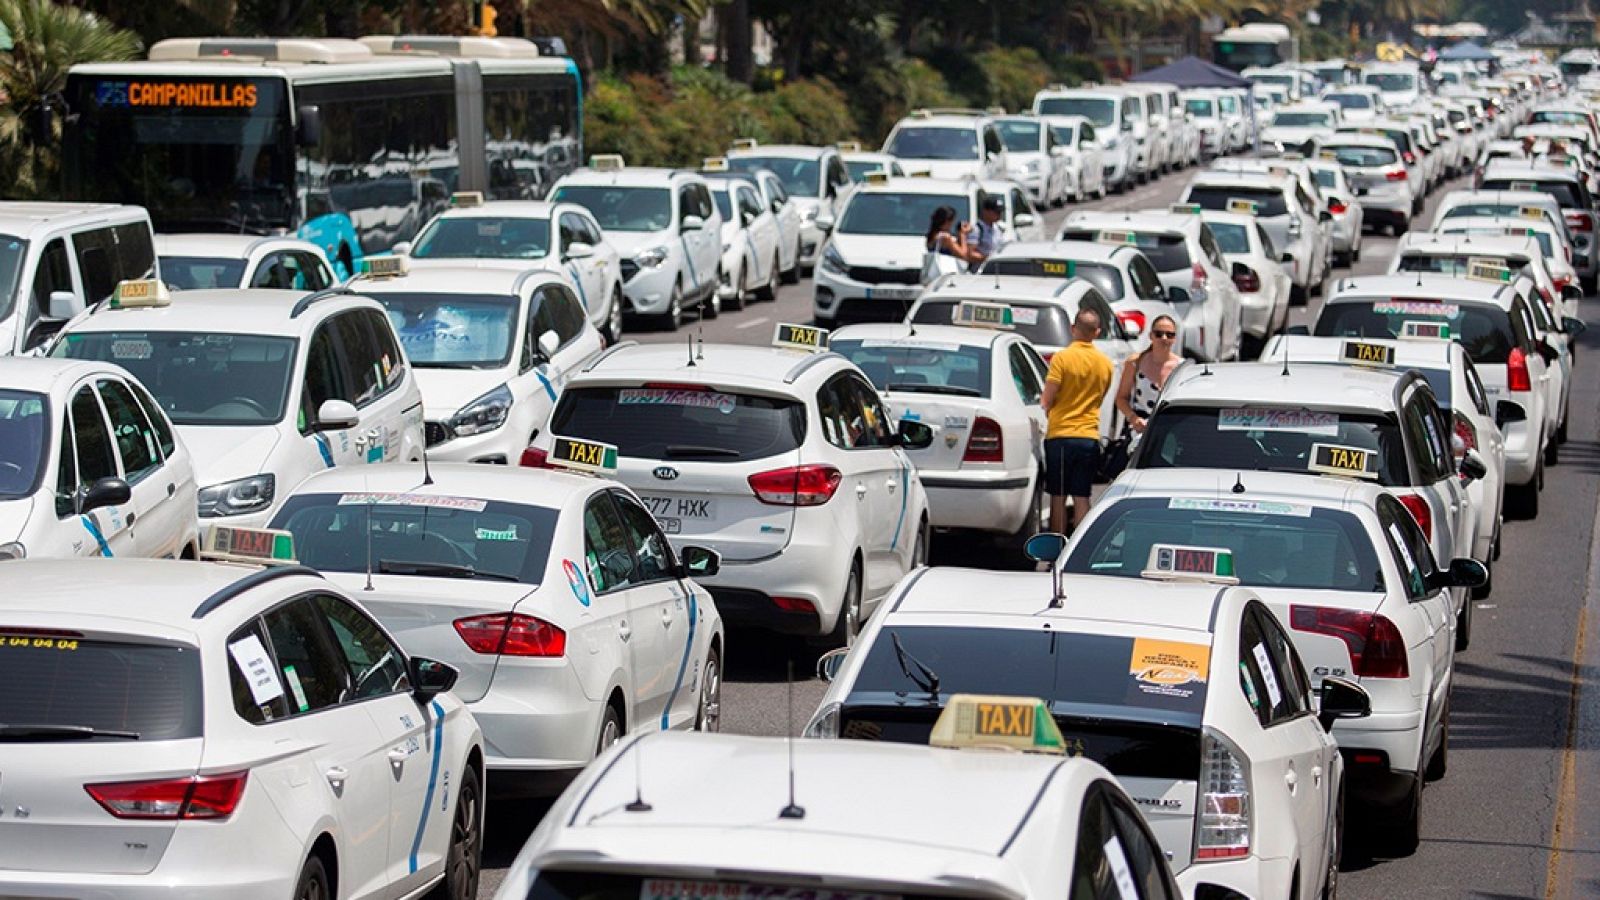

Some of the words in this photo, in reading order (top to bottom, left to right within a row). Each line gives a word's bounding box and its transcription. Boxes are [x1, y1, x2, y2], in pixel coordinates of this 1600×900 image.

[129, 82, 257, 107] CAMPANILLAS
[1043, 262, 1067, 274] TAXI
[122, 282, 148, 297] TAXI
[789, 326, 817, 346] TAXI
[1356, 343, 1387, 363] TAXI
[568, 441, 604, 465] TAXI
[1330, 448, 1365, 471] TAXI
[656, 469, 677, 480] KIA
[677, 499, 710, 517] HXK
[235, 528, 274, 557] TAXI
[1177, 550, 1214, 575] TAXI
[10, 638, 29, 647] 04
[33, 639, 53, 648] 04
[57, 640, 78, 650] 04
[1313, 665, 1346, 677] C5
[979, 703, 1032, 736] TAXI
